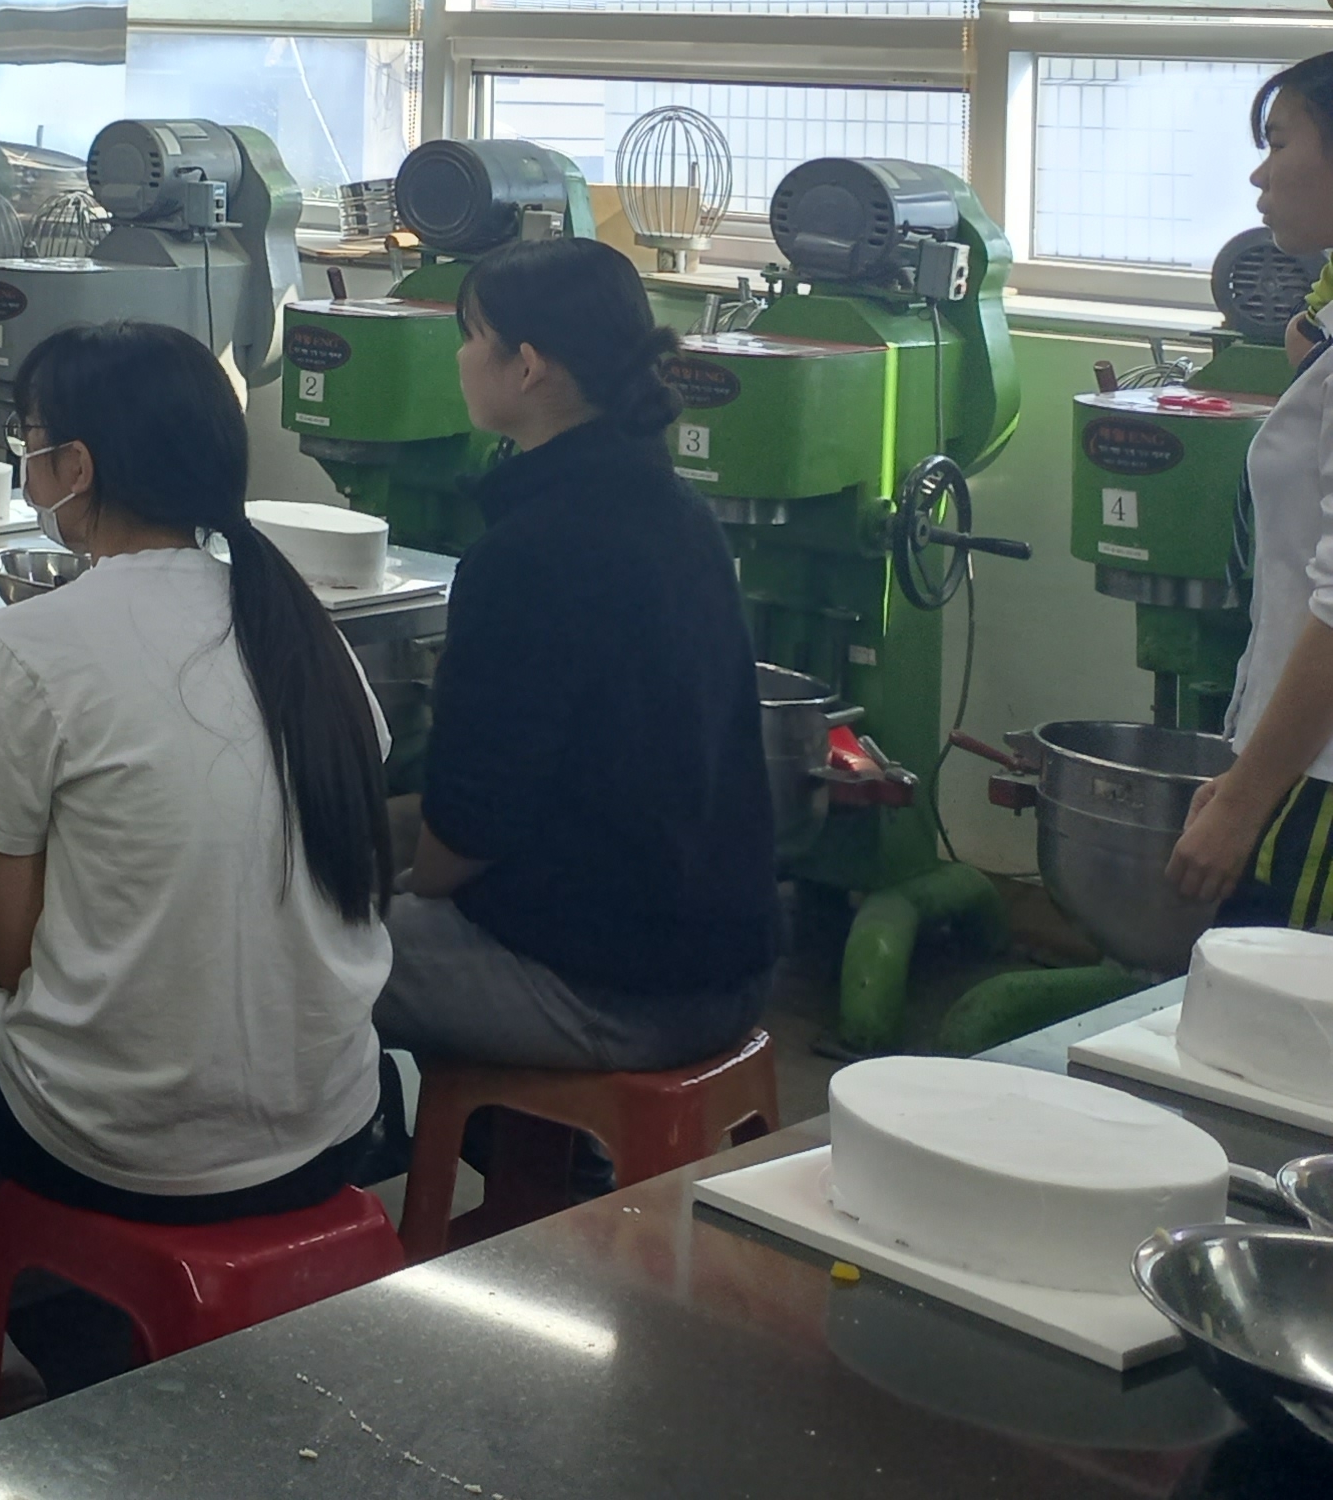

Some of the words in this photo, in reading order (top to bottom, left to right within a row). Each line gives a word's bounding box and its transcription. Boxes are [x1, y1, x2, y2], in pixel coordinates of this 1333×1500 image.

[305, 375, 318, 397] 2
[686, 429, 700, 453] 3
[1110, 496, 1126, 521] 4
